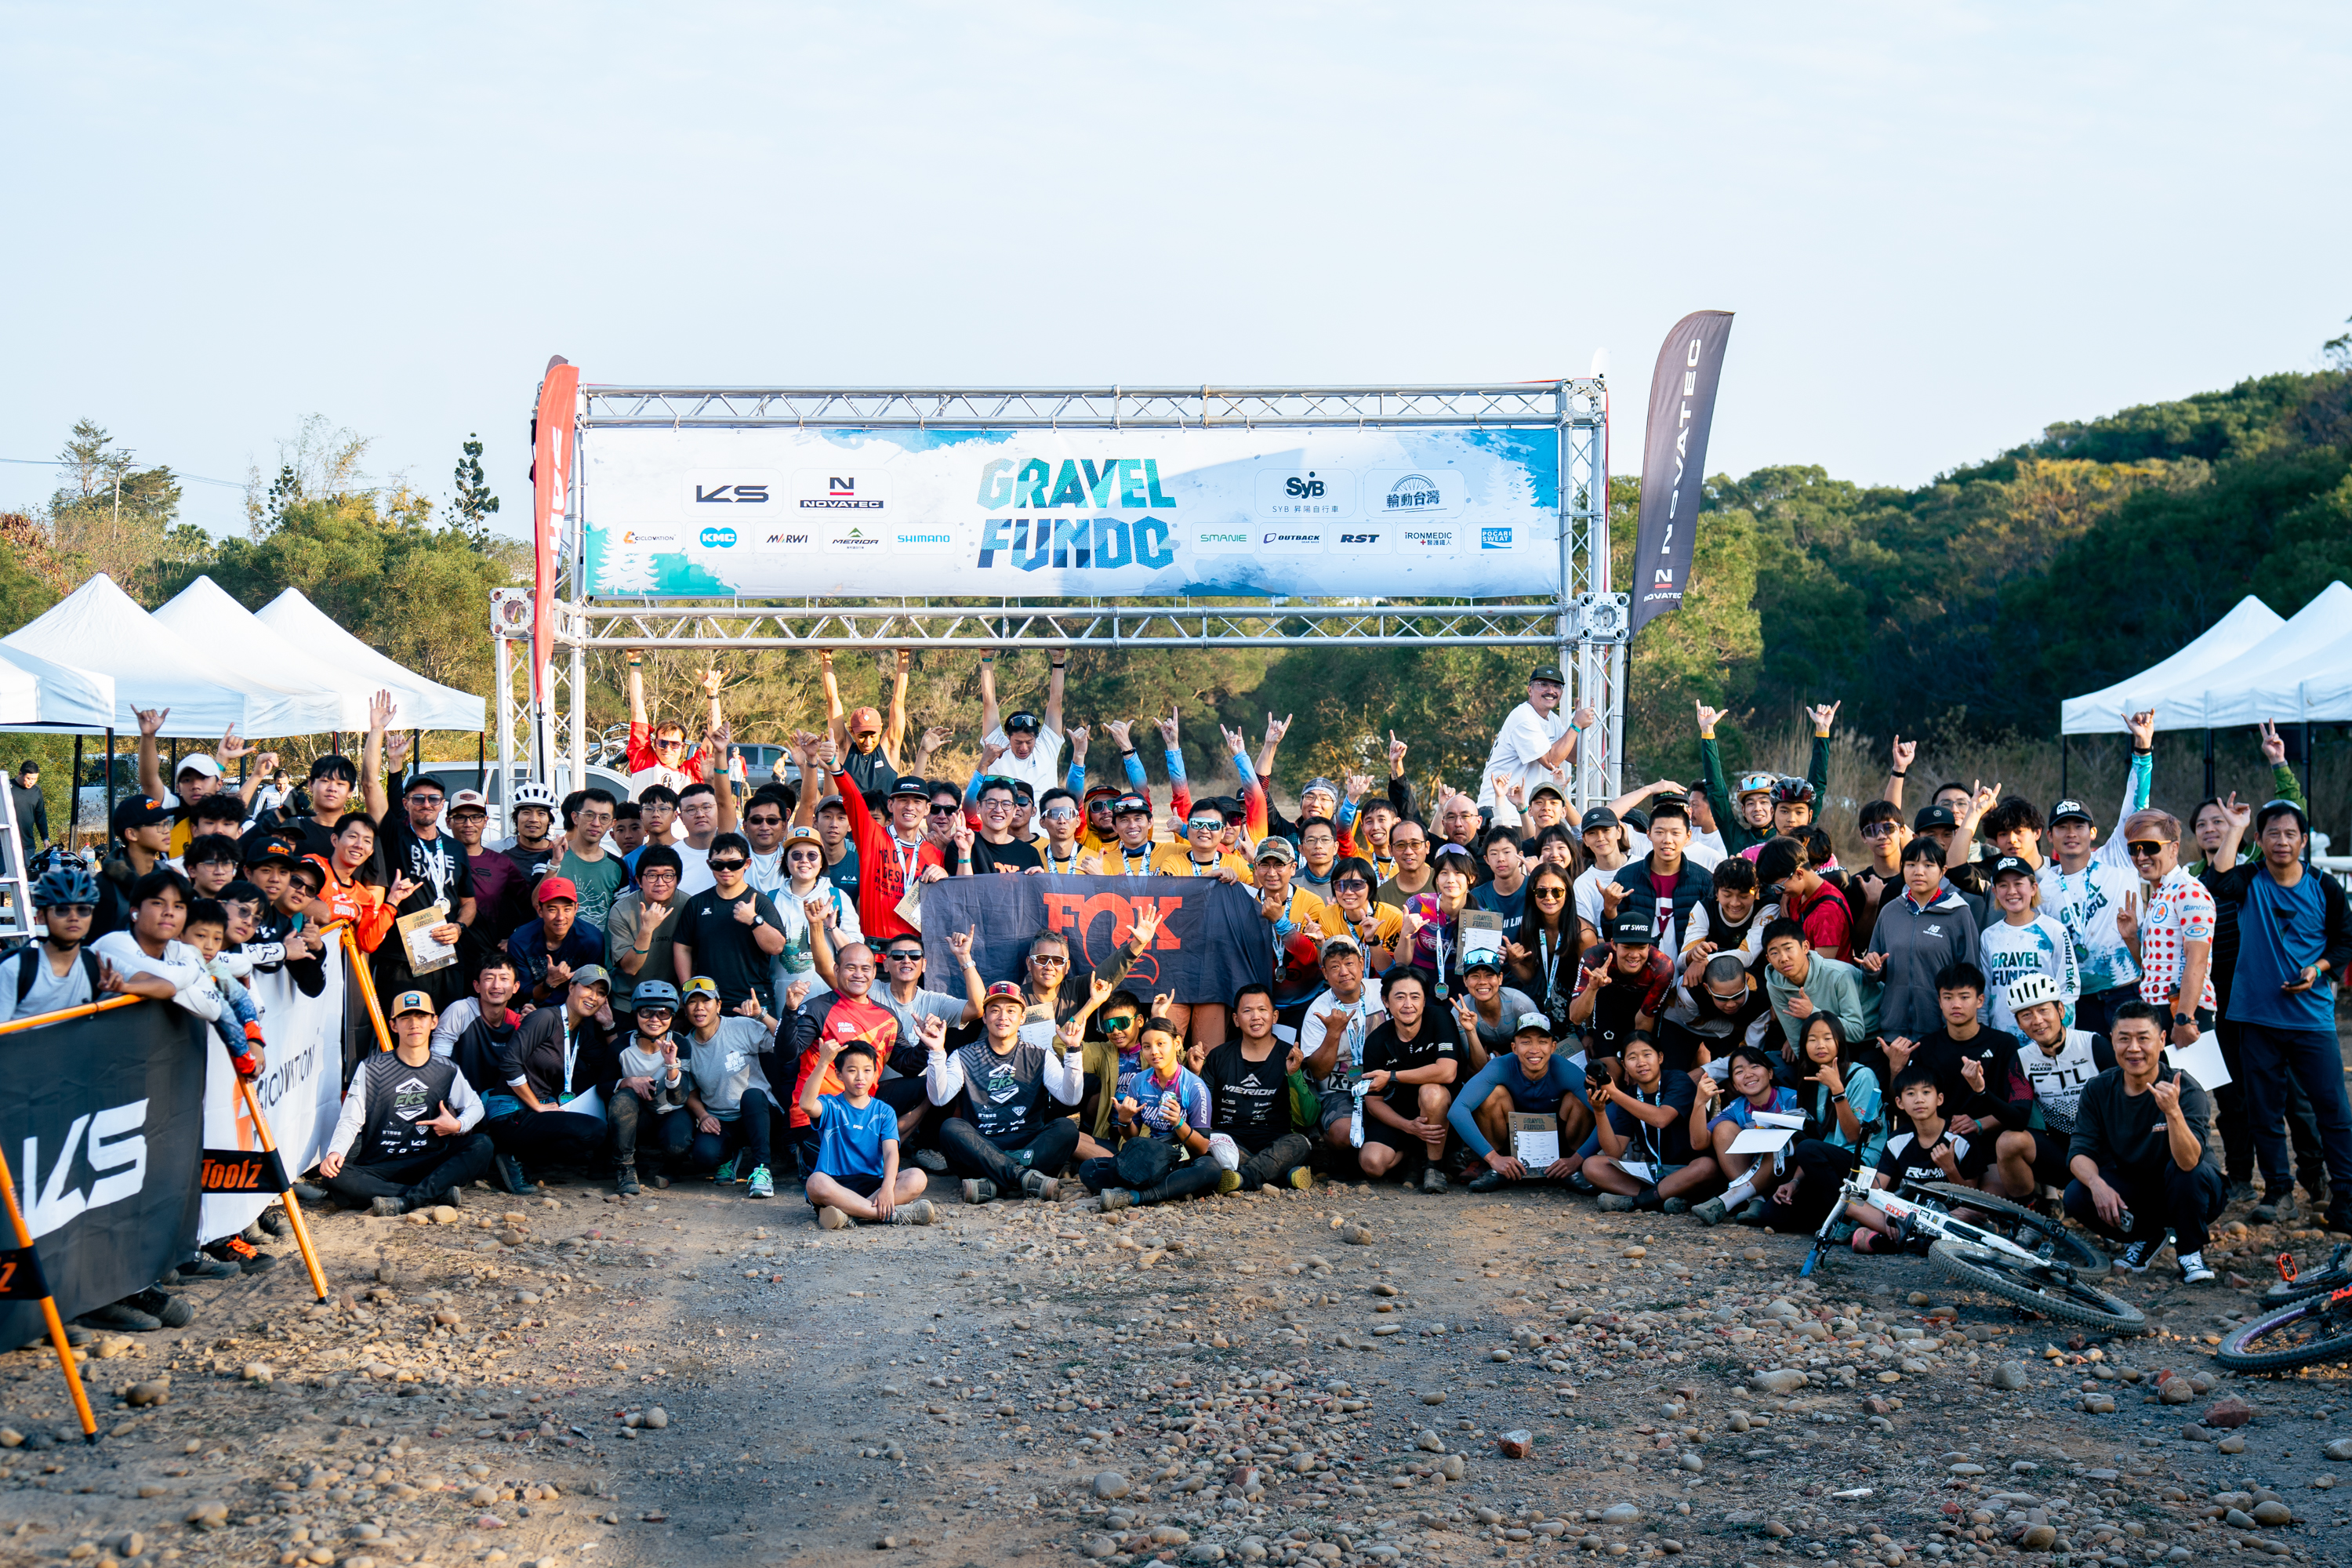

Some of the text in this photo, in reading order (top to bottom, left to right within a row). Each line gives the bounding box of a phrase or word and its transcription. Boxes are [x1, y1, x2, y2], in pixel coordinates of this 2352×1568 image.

[1661, 338, 1701, 554] NOVATEC
[829, 477, 855, 490] N
[976, 457, 1177, 510] GRAVEL
[695, 485, 769, 503] KS
[1386, 490, 1440, 508] 輪動台灣
[1294, 505, 1339, 514] 昇陽自行車
[702, 533, 735, 542] KMC
[977, 516, 1175, 572] FUNDO
[1340, 534, 1381, 543] RST
[1654, 568, 1673, 583] N
[412, 911, 434, 923] GRAVEL
[1043, 891, 1183, 952] FOX
[1472, 913, 1494, 922] GRAVEL
[1991, 952, 2042, 968] GRAVEL
[1992, 969, 2039, 987] FUN
[1221, 1084, 1278, 1096] MERIDA
[1194, 1082, 1208, 1125] MERIDA
[1144, 1120, 1171, 1131] CLASSIC
[23, 1098, 149, 1240] KS
[1905, 1166, 1938, 1179] RUN
